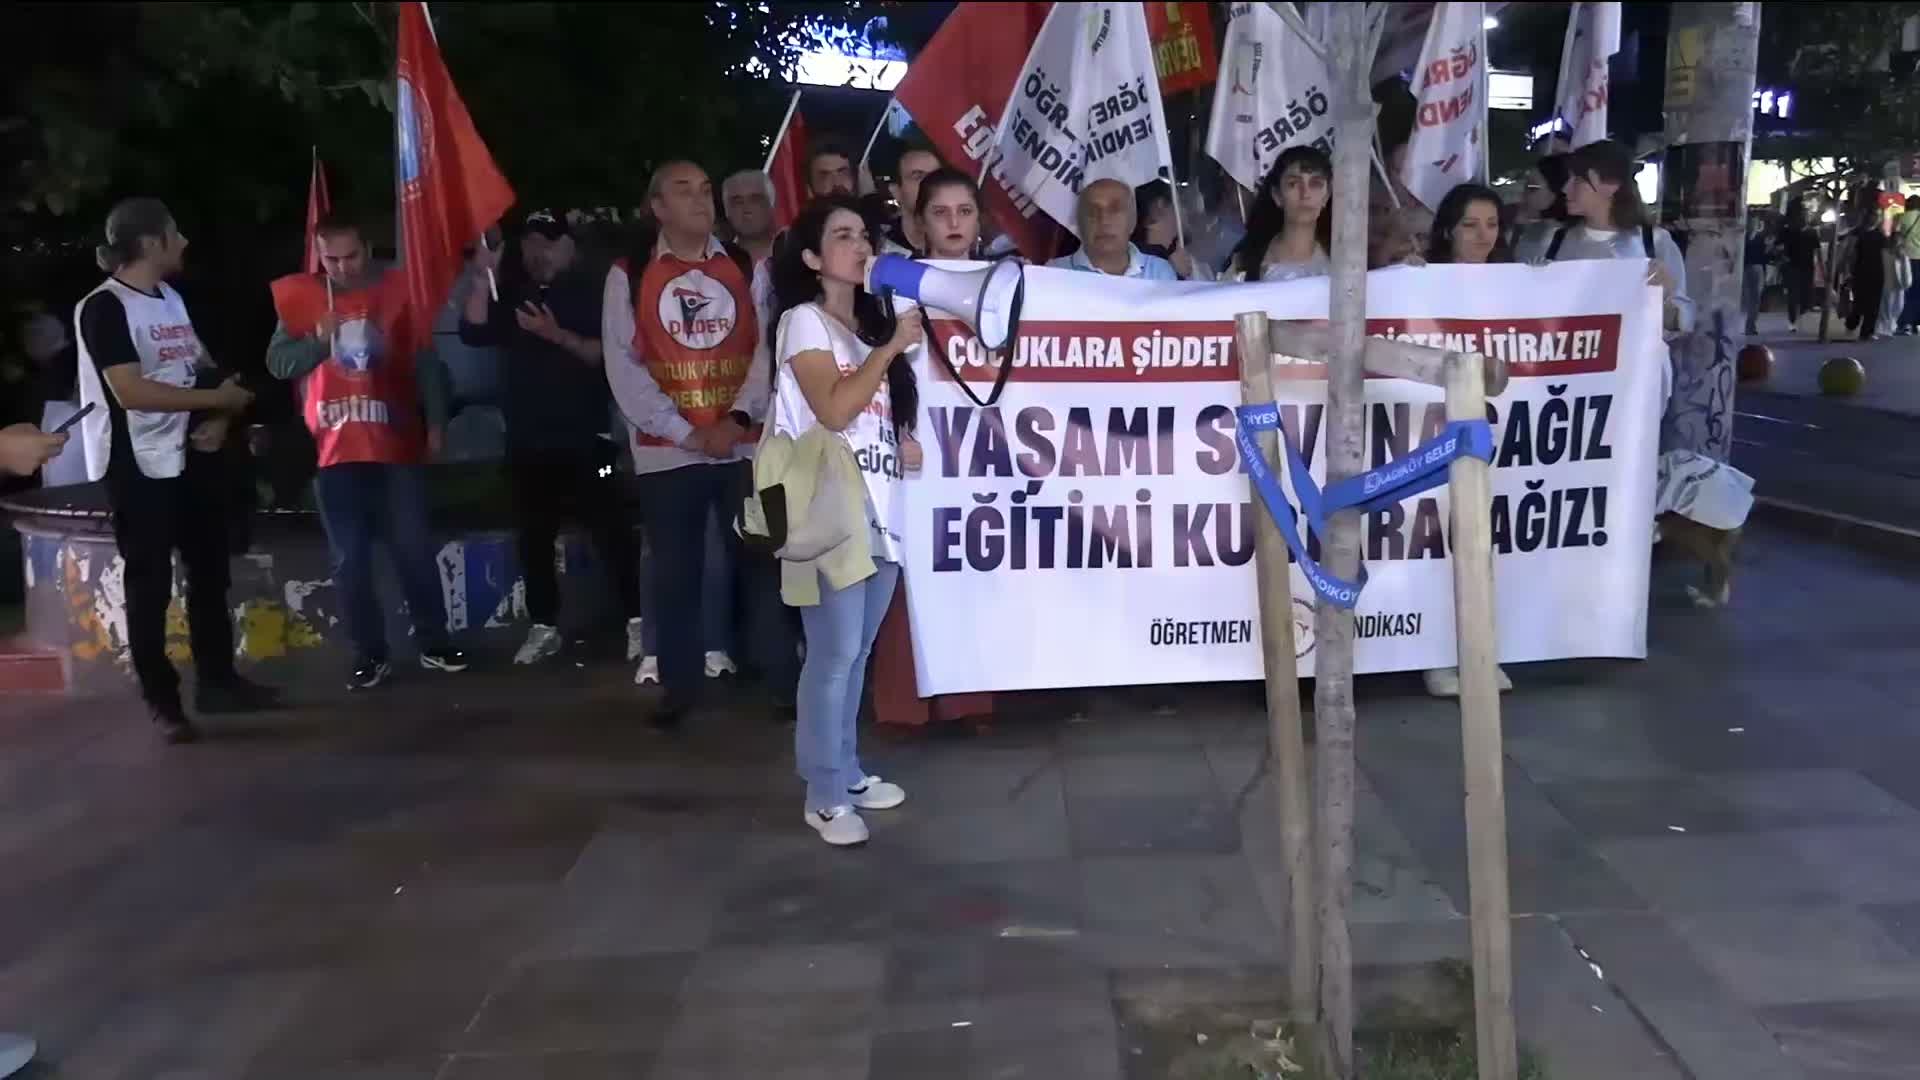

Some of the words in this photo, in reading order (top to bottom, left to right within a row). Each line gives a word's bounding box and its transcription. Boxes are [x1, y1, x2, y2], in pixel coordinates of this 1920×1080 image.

[1132, 329, 1233, 375] ŞİDDET
[1571, 330, 1601, 360] ET!
[927, 404, 1175, 496] YAŞAMI
[932, 487, 1153, 572] EĞİTİMİ
[1149, 617, 1252, 646] ÖĞRETMEN
